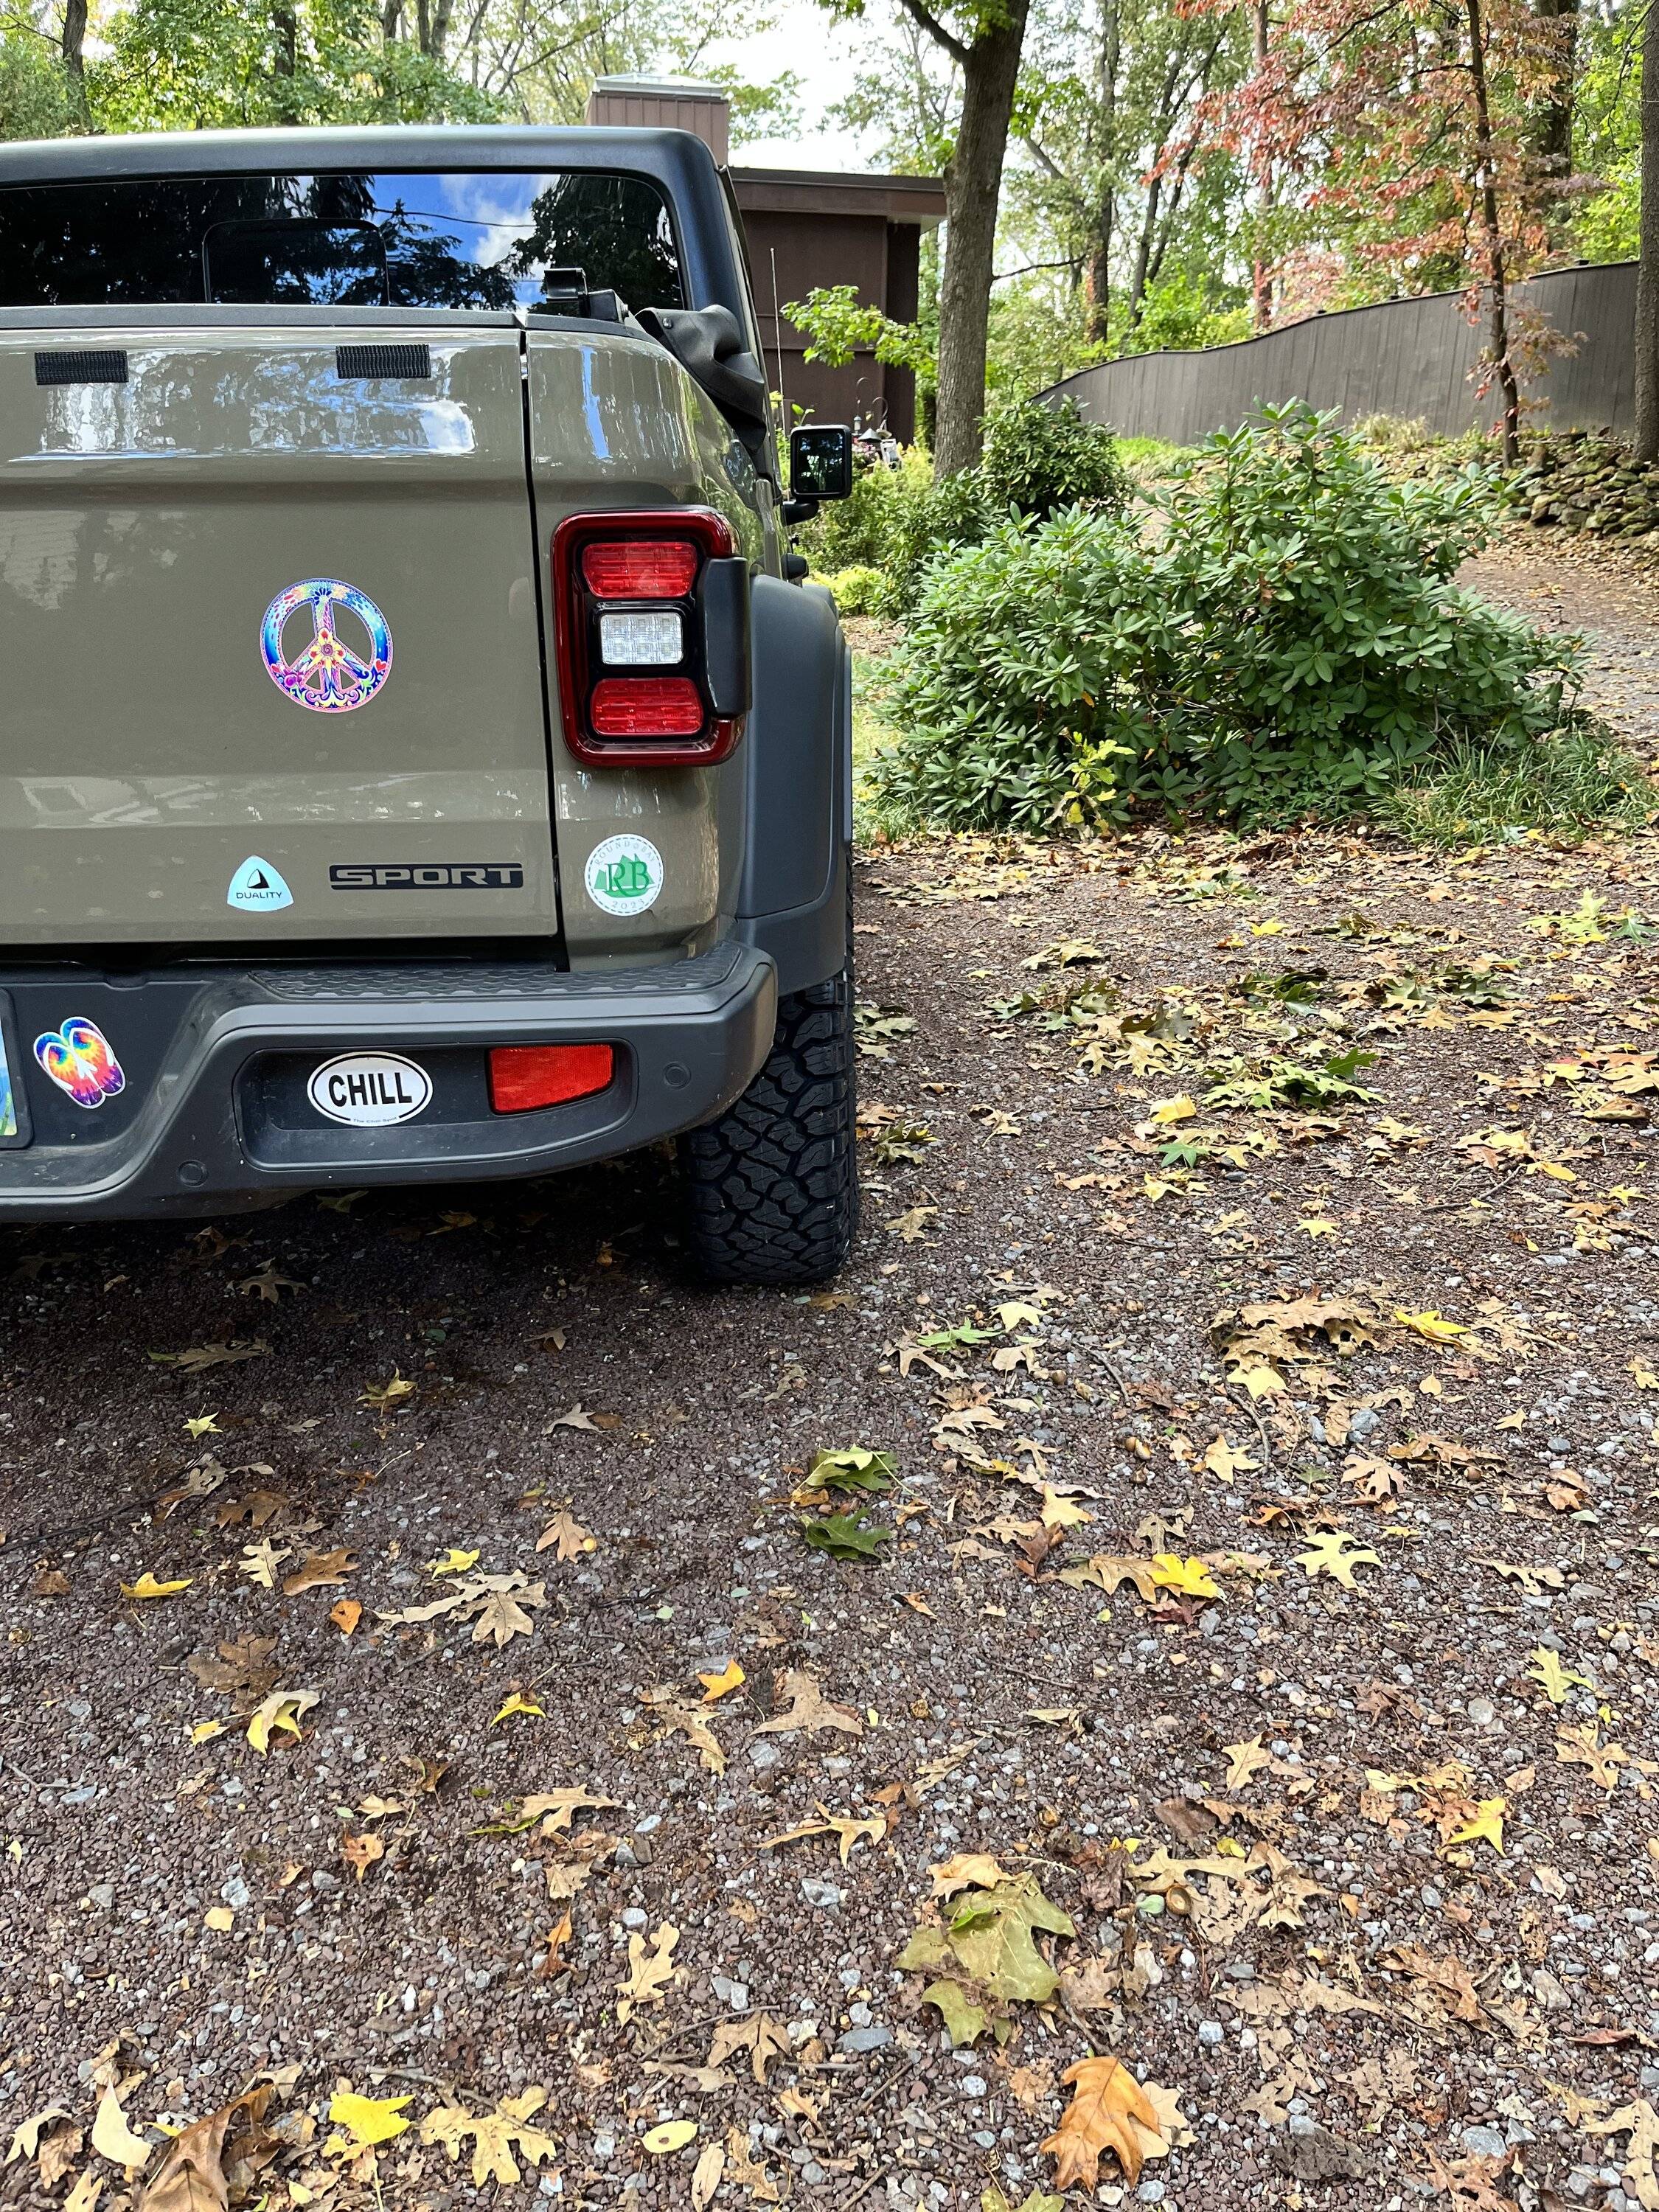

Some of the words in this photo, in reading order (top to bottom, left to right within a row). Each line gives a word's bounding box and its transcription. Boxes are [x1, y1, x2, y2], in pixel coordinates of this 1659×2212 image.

[594, 840, 630, 865] ROUND
[641, 847, 656, 862] BAY
[330, 867, 523, 886] SPORT
[605, 861, 650, 897] RB
[328, 1072, 412, 1107] CHILL
